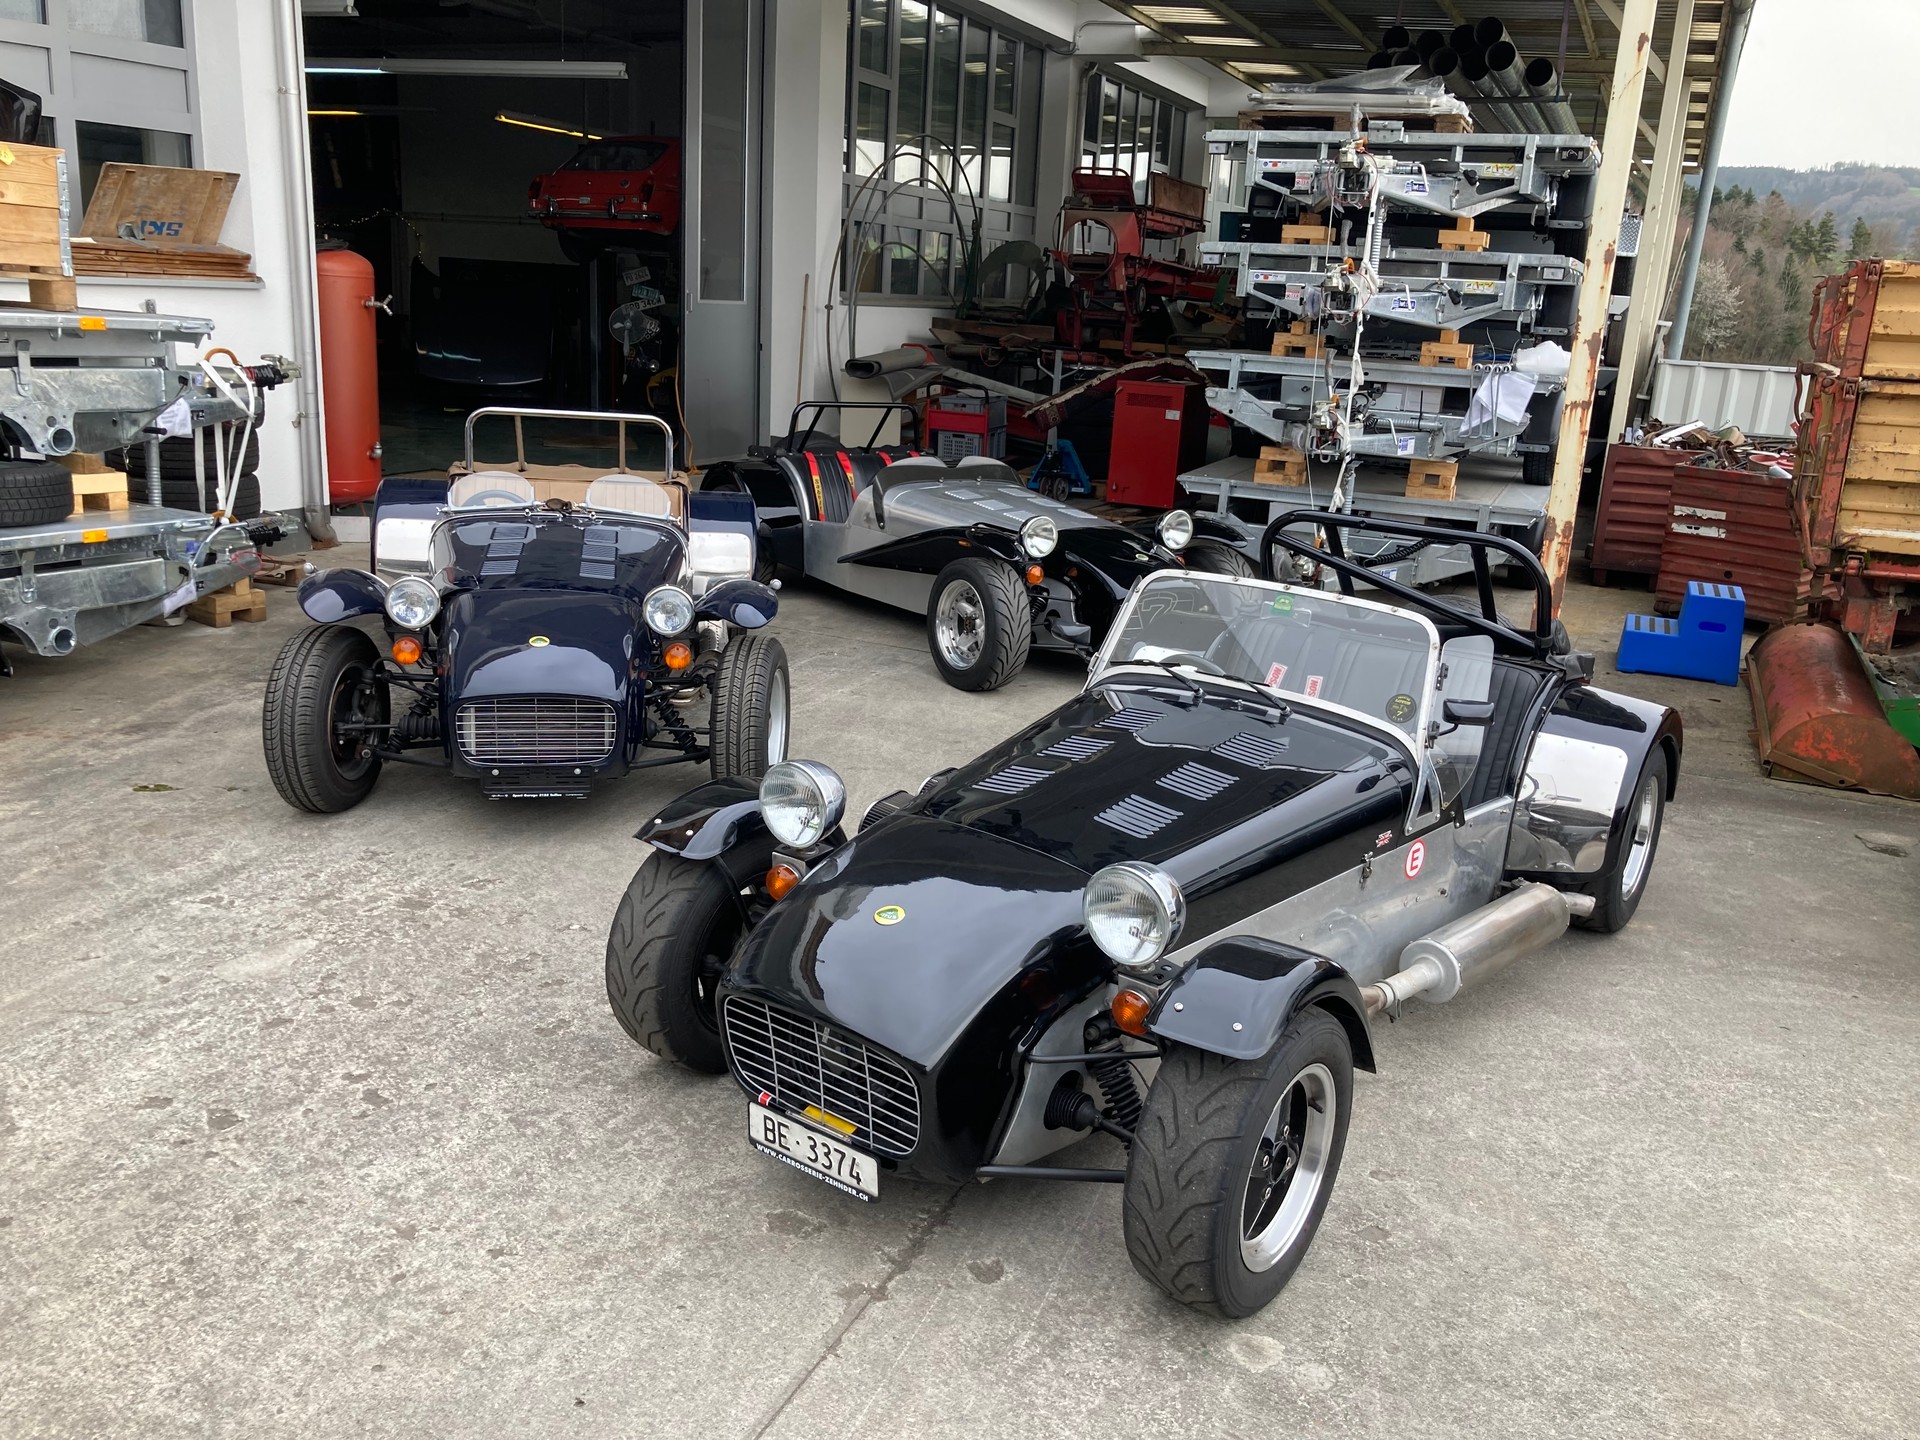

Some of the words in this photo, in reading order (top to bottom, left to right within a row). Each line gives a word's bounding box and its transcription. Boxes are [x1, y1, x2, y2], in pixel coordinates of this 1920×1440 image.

[1410, 847, 1421, 871] E
[763, 1114, 791, 1152] BE
[806, 1135, 863, 1186] 3374
